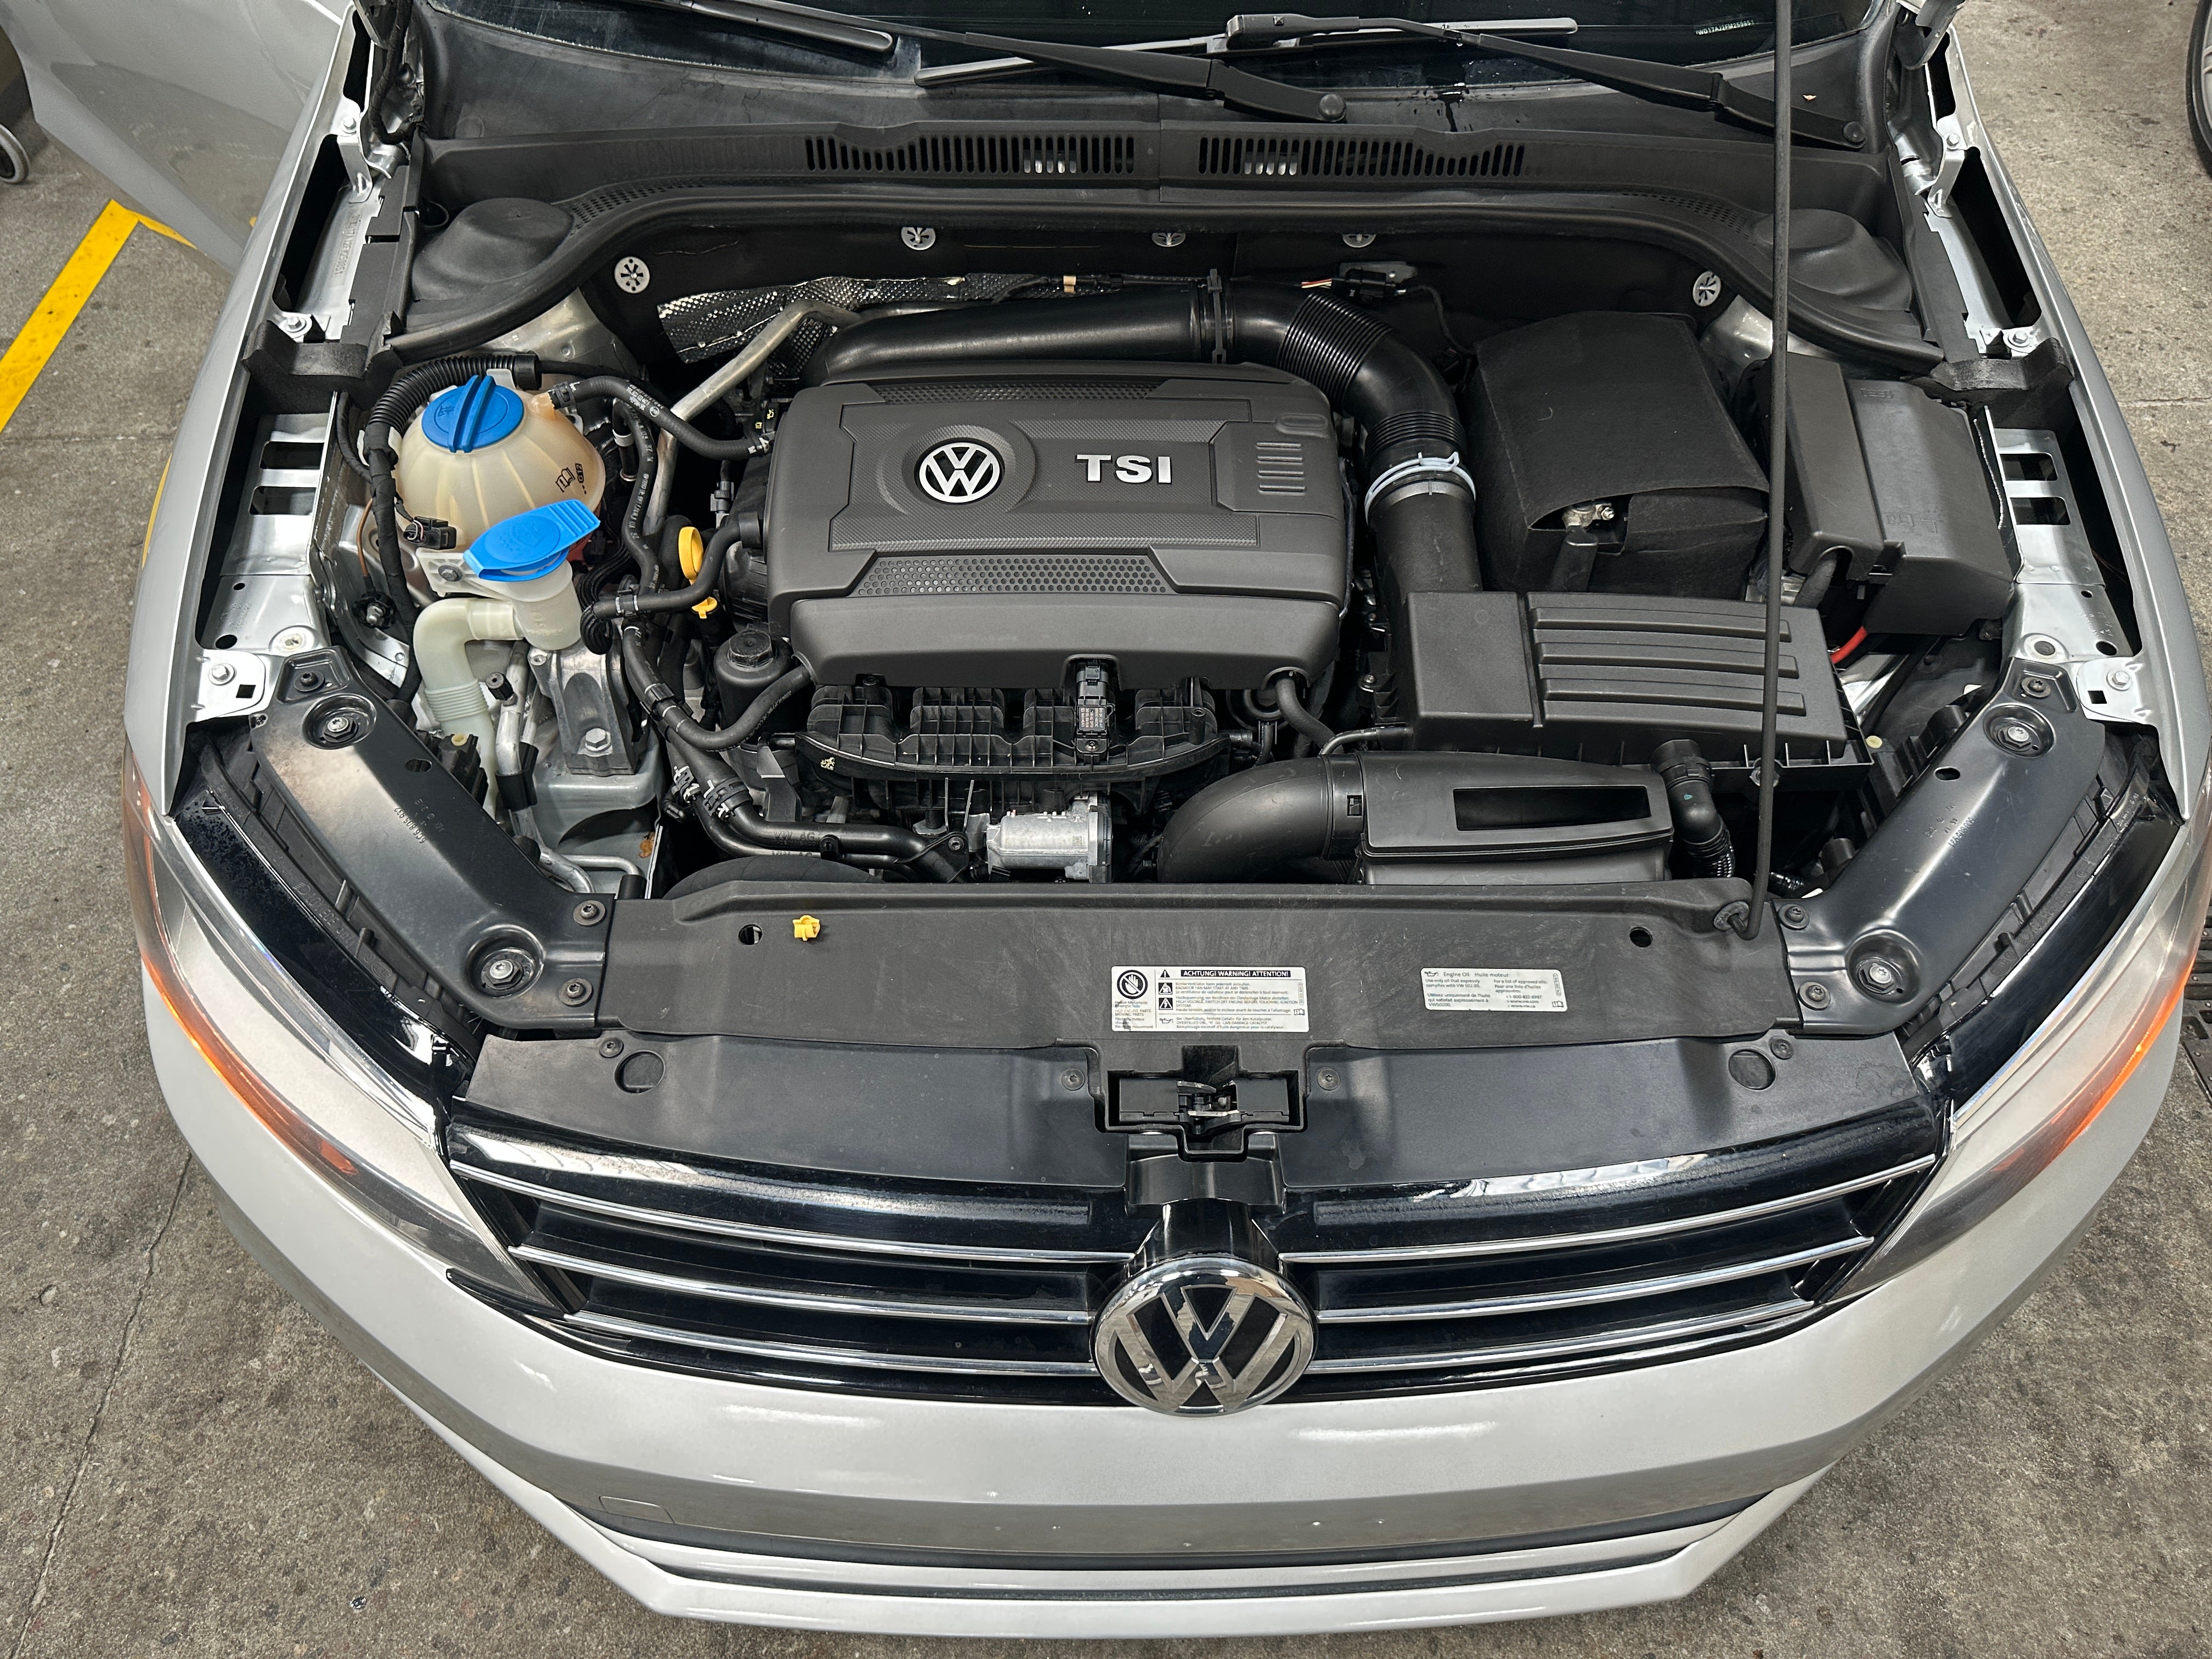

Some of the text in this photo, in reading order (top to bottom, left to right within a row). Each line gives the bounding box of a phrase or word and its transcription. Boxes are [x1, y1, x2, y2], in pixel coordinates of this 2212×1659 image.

[919, 442, 1000, 503] VW
[1077, 454, 1172, 484] TSI
[1094, 1255, 1316, 1418] VW
